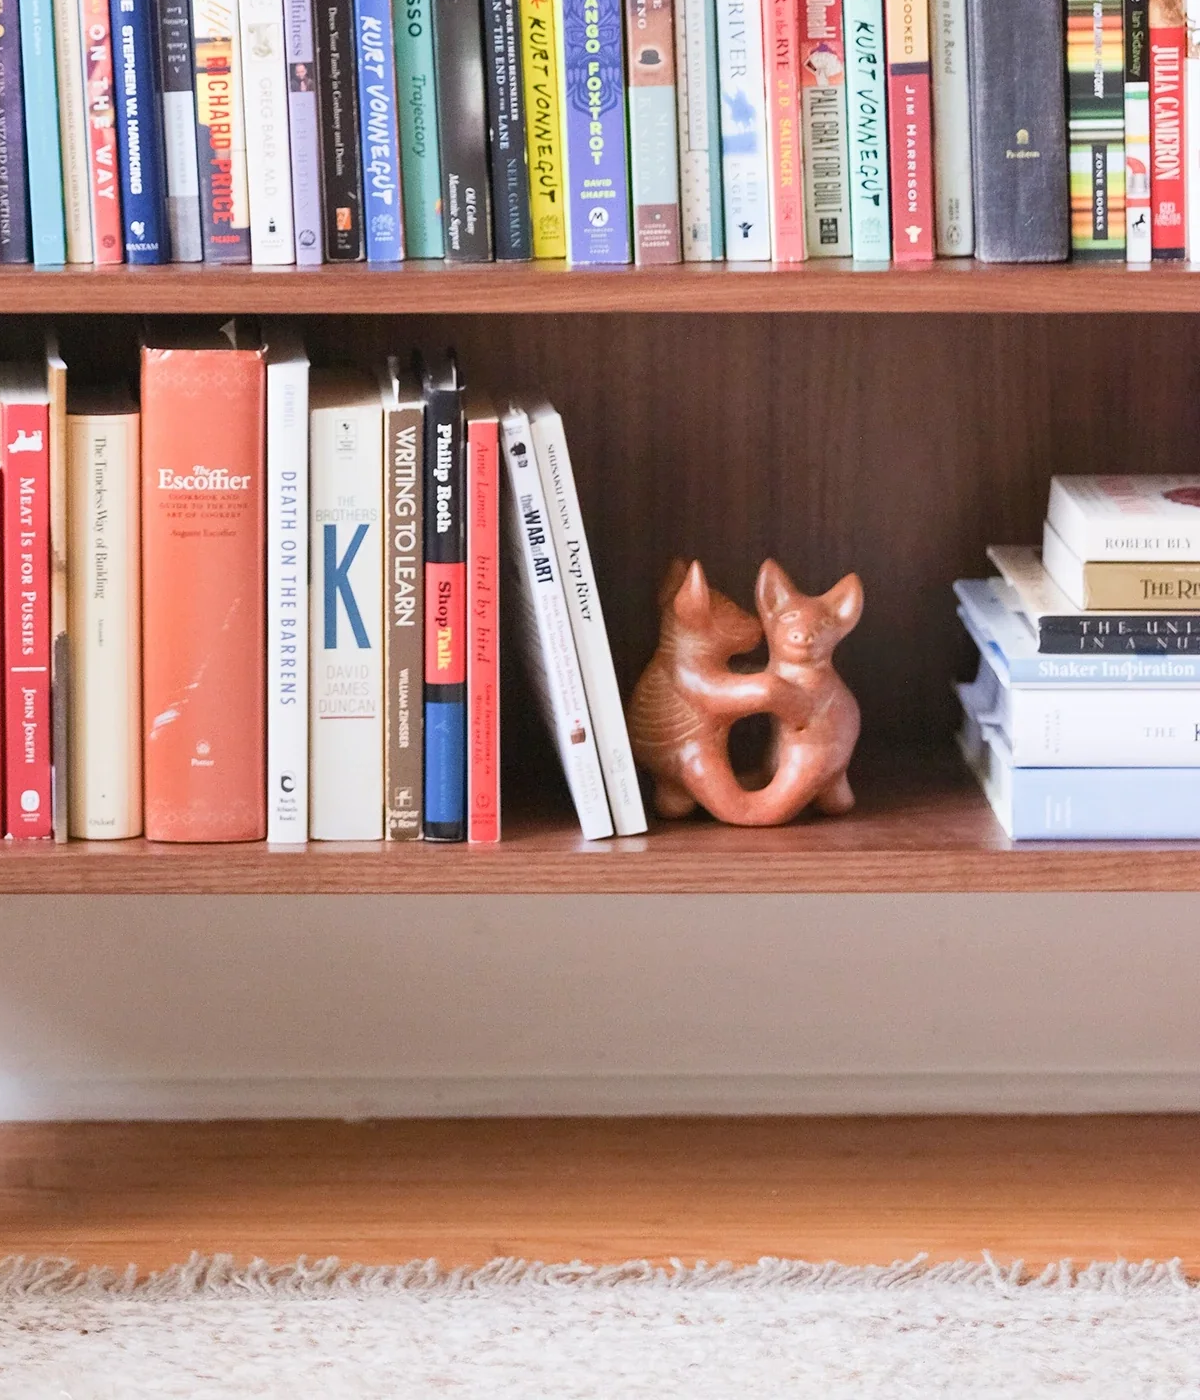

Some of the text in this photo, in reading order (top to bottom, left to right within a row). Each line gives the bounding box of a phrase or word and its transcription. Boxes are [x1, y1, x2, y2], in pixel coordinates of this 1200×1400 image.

[121, 24, 137, 96] STEPHEN
[360, 15, 386, 80] KURT
[505, 8, 515, 33] YORK
[506, 35, 516, 63] TIMES
[728, 1, 748, 80] RIVER
[943, 13, 955, 35] the
[944, 40, 957, 76] Road
[125, 97, 138, 118] W.
[507, 65, 519, 121] BESTSELLER
[1150, 44, 1180, 94] JULIA
[89, 24, 115, 200] ON THE WAY
[206, 56, 235, 225] RICHARD PRICE
[365, 85, 397, 206] VONNEGUT
[408, 73, 428, 159] Trajectory
[527, 15, 558, 204] KURT VONNEGUT
[587, 61, 605, 165] FOXTROT
[855, 20, 882, 207] KURT VONNEGUT
[904, 84, 918, 213] JIM HARRISON
[1153, 96, 1181, 182] CAMERON
[0, 166, 8, 182] OF
[127, 119, 143, 195] HAWKING
[583, 178, 613, 188] DAVID
[810, 88, 843, 215] PALE GRAY FOR GUILT
[0, 184, 12, 245] EARTHSEA
[506, 157, 522, 249] NEIL GAIMAN
[1095, 152, 1105, 231] ZONE BOOKS
[93, 436, 108, 600] The Timeless Way of Building
[156, 467, 252, 491] Escoffier
[315, 509, 378, 523] BROTHERS
[337, 495, 356, 507] THE
[433, 423, 453, 534] Philip Roth
[475, 441, 490, 529] Anne Lamott
[394, 425, 417, 627] WRITING TO LEARN
[1104, 537, 1192, 550] ROBERT BLY
[20, 477, 38, 656] MEAT IS FOR PUSSIES
[280, 471, 298, 706] DEATH ON THE BARRENS
[323, 523, 372, 650] K
[566, 539, 594, 623] Deep River
[473, 554, 492, 664] bird by bird
[318, 698, 376, 715] DUNCAN
[324, 682, 371, 697] JAMES
[325, 664, 370, 680] DAVID
[398, 667, 410, 749] WILLIAM ZINSSER
[1038, 658, 1196, 681] Shaker Inspiration
[22, 687, 38, 764] JOHN JOSEPH
